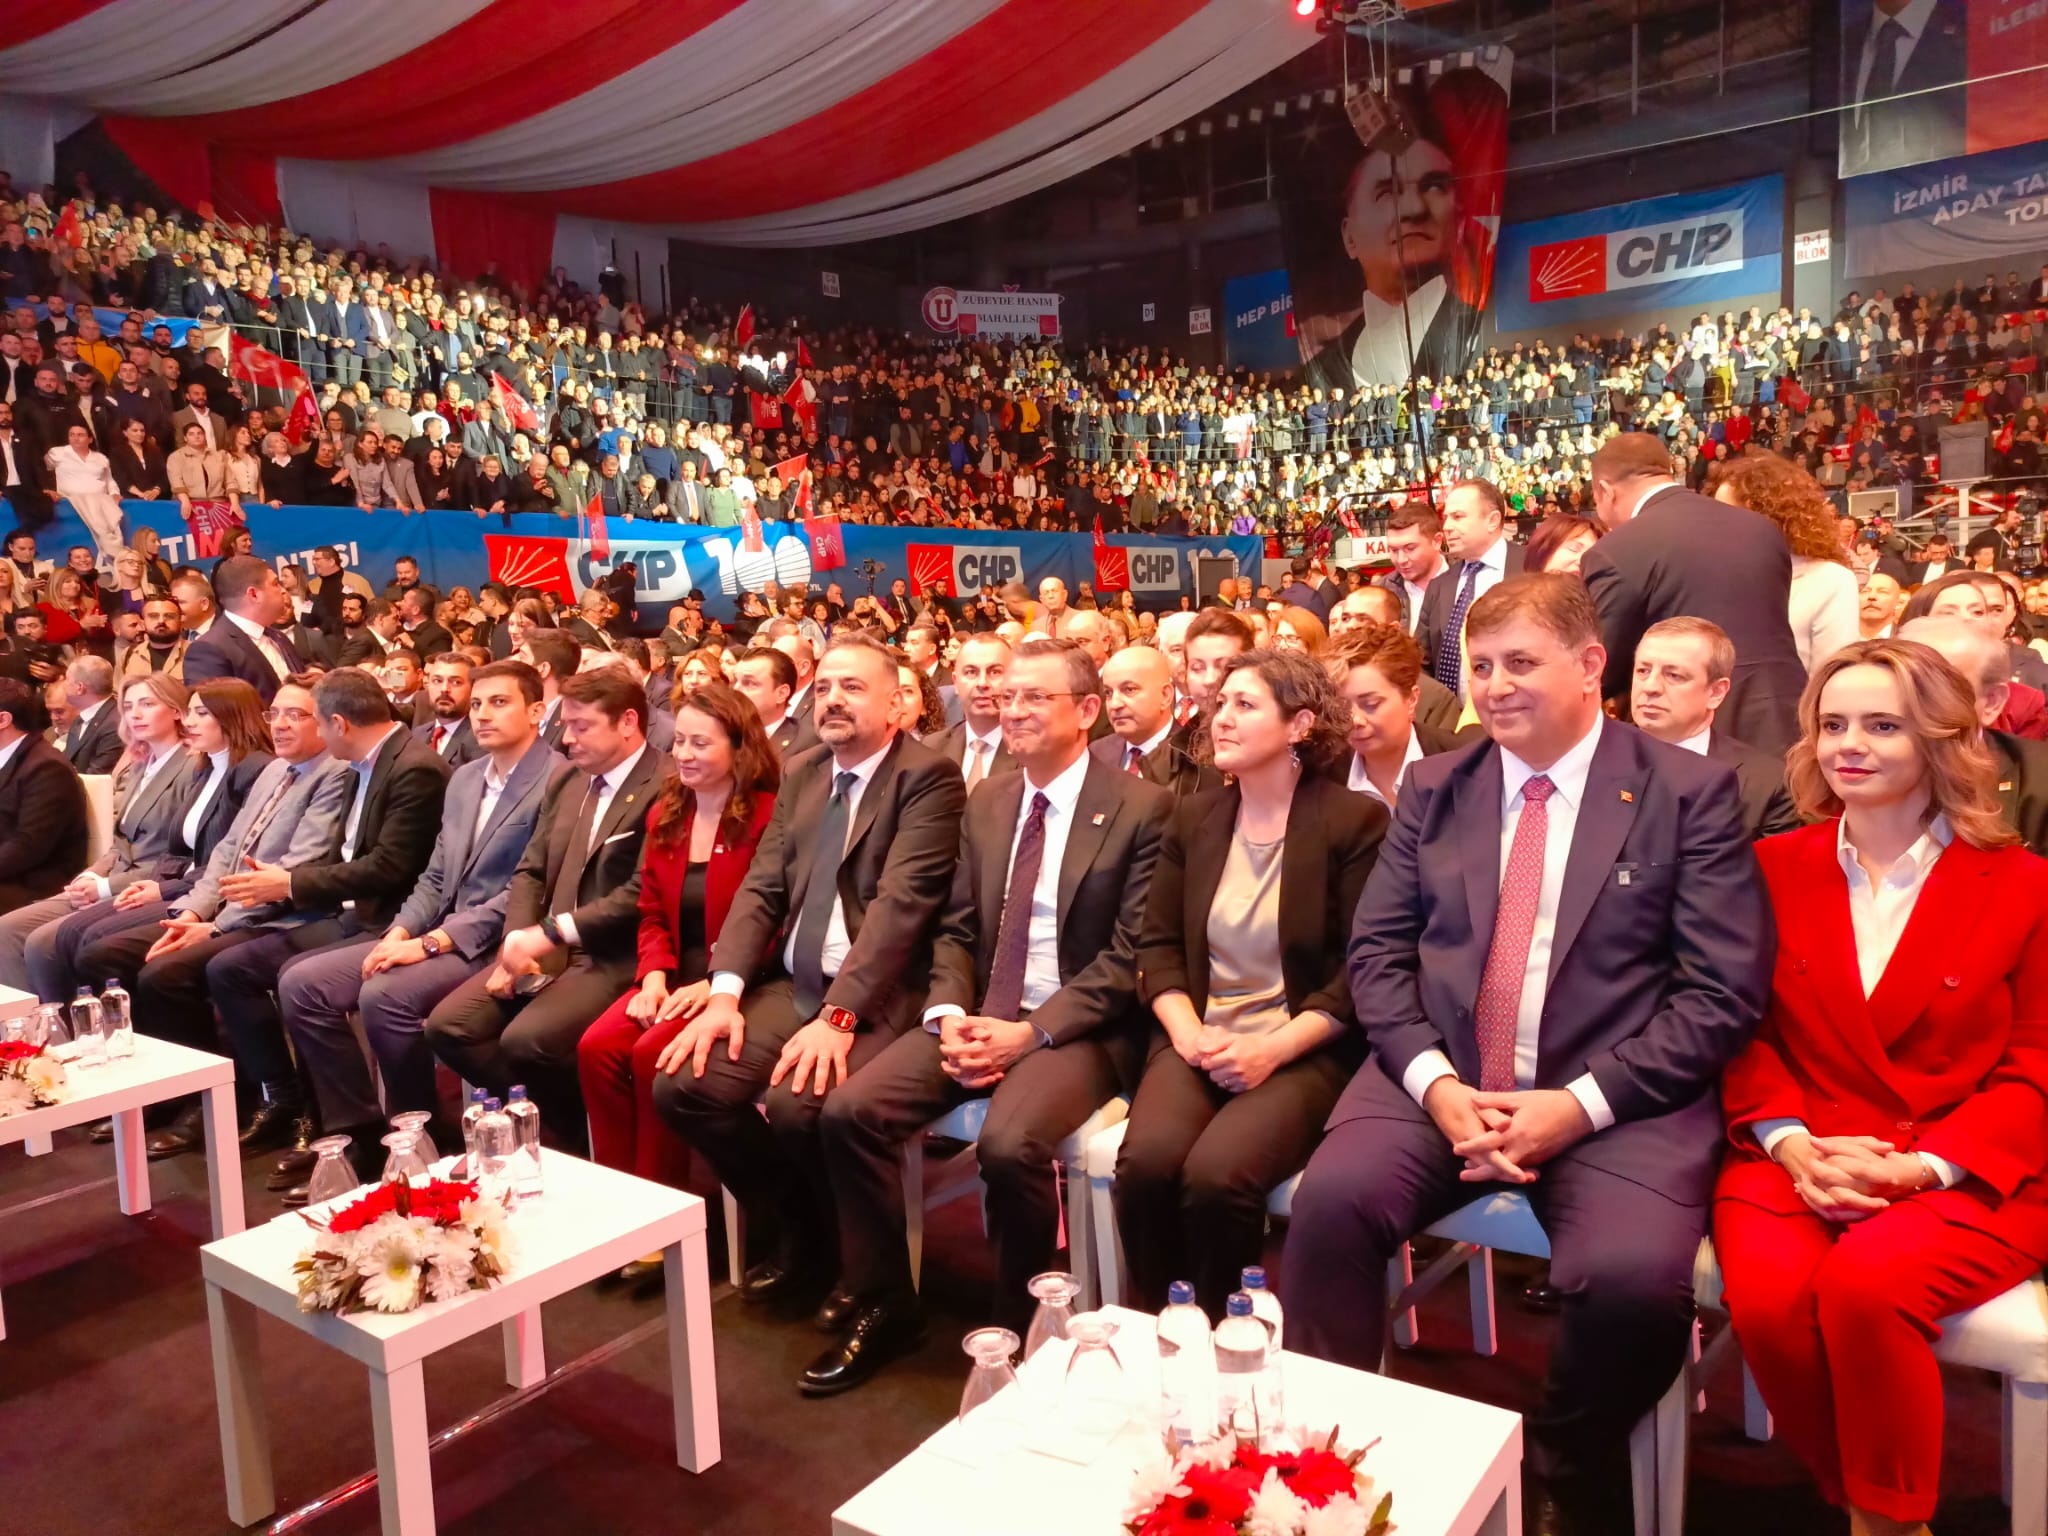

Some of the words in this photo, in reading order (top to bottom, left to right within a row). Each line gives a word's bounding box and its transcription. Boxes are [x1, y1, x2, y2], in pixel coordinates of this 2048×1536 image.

[1894, 174, 1967, 214] İZMİR
[1933, 185, 2005, 226] ADAY
[2013, 173, 2048, 197] TA
[1616, 223, 1732, 277] CHP
[1797, 246, 1827, 260] BLOK
[1802, 234, 1822, 246] D-1
[962, 294, 1016, 306] ZÜBEYDE
[1017, 296, 1053, 307] HANIM
[1190, 322, 1210, 332] BLOK
[1236, 306, 1267, 328] HEP
[193, 506, 213, 536] CHP
[815, 536, 827, 558] CHP
[1366, 541, 1390, 555] KA
[703, 535, 811, 595] 100
[958, 554, 1016, 589] CHP
[1131, 554, 1174, 584] CHP
